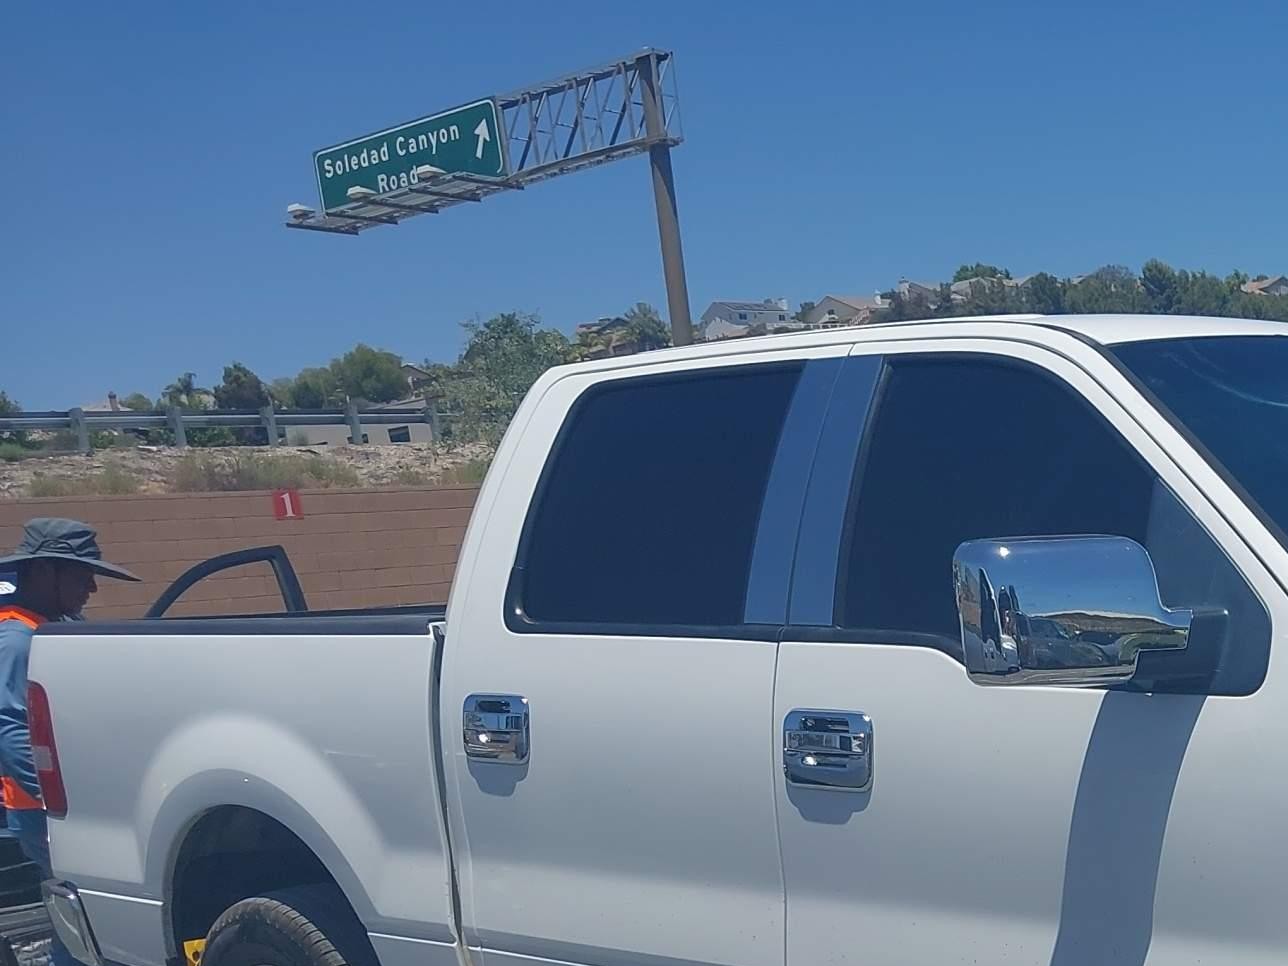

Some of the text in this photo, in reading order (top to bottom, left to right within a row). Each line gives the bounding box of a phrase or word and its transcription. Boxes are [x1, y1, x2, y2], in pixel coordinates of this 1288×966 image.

[324, 124, 460, 178] Soledad Canyon
[377, 165, 419, 193] Road
[281, 492, 297, 517] 1
